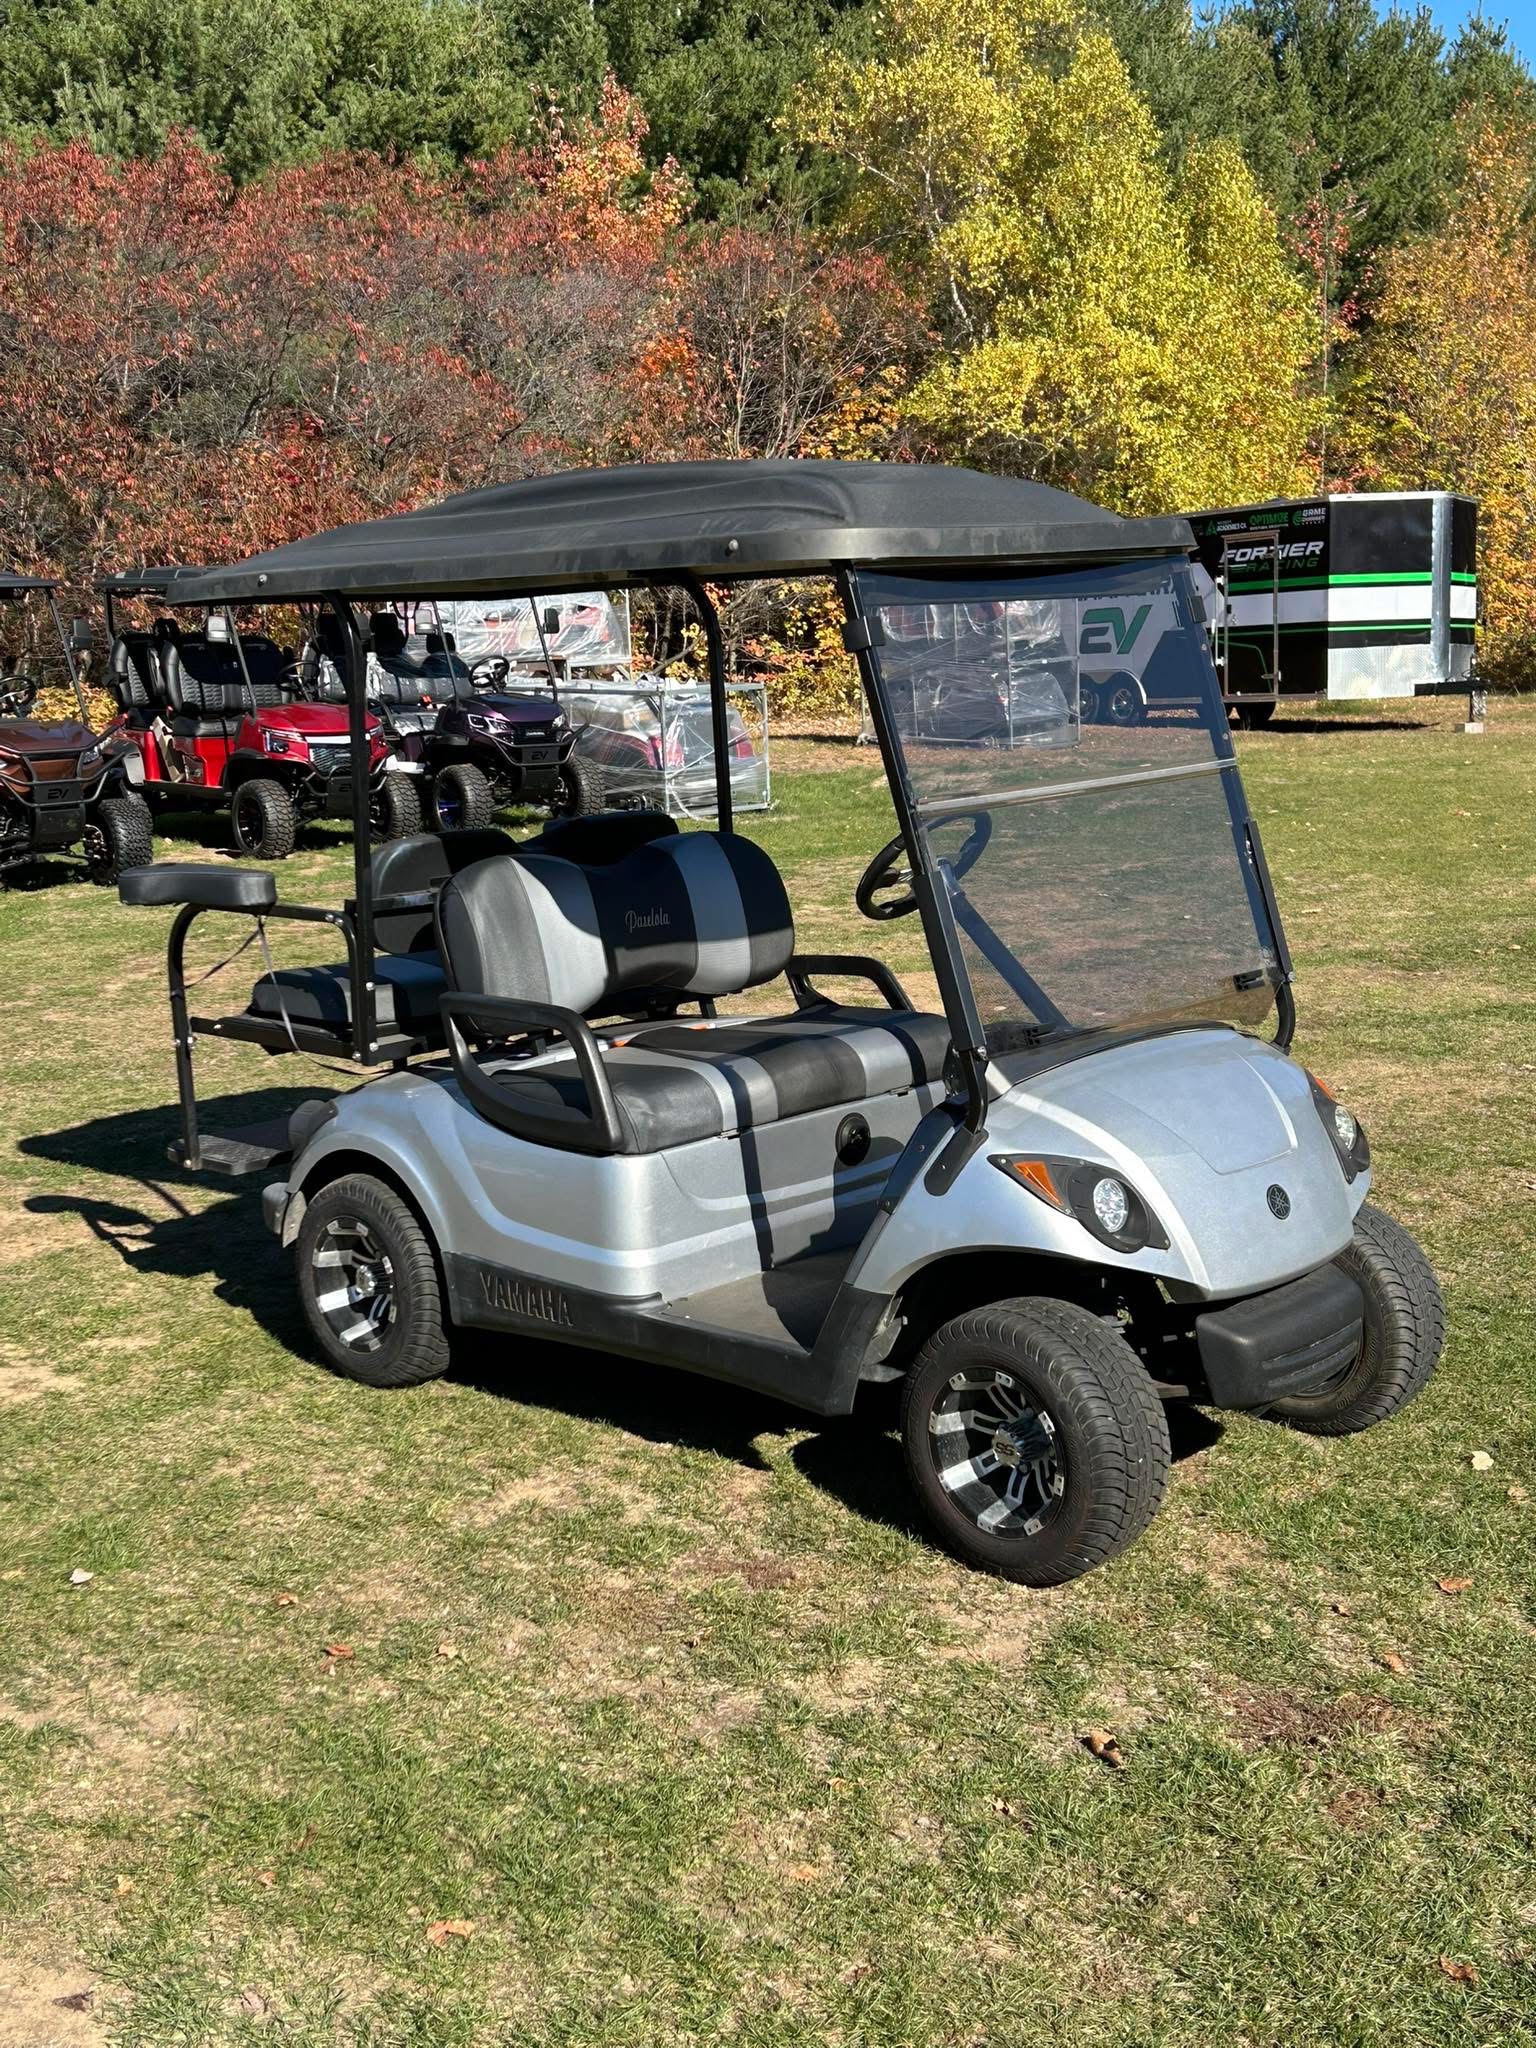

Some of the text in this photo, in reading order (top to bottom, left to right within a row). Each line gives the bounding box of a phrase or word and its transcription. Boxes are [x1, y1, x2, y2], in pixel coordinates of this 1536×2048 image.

[1079, 604, 1153, 655] EV
[47, 788, 70, 800] EV
[480, 1271, 574, 1327] YAMAHA
